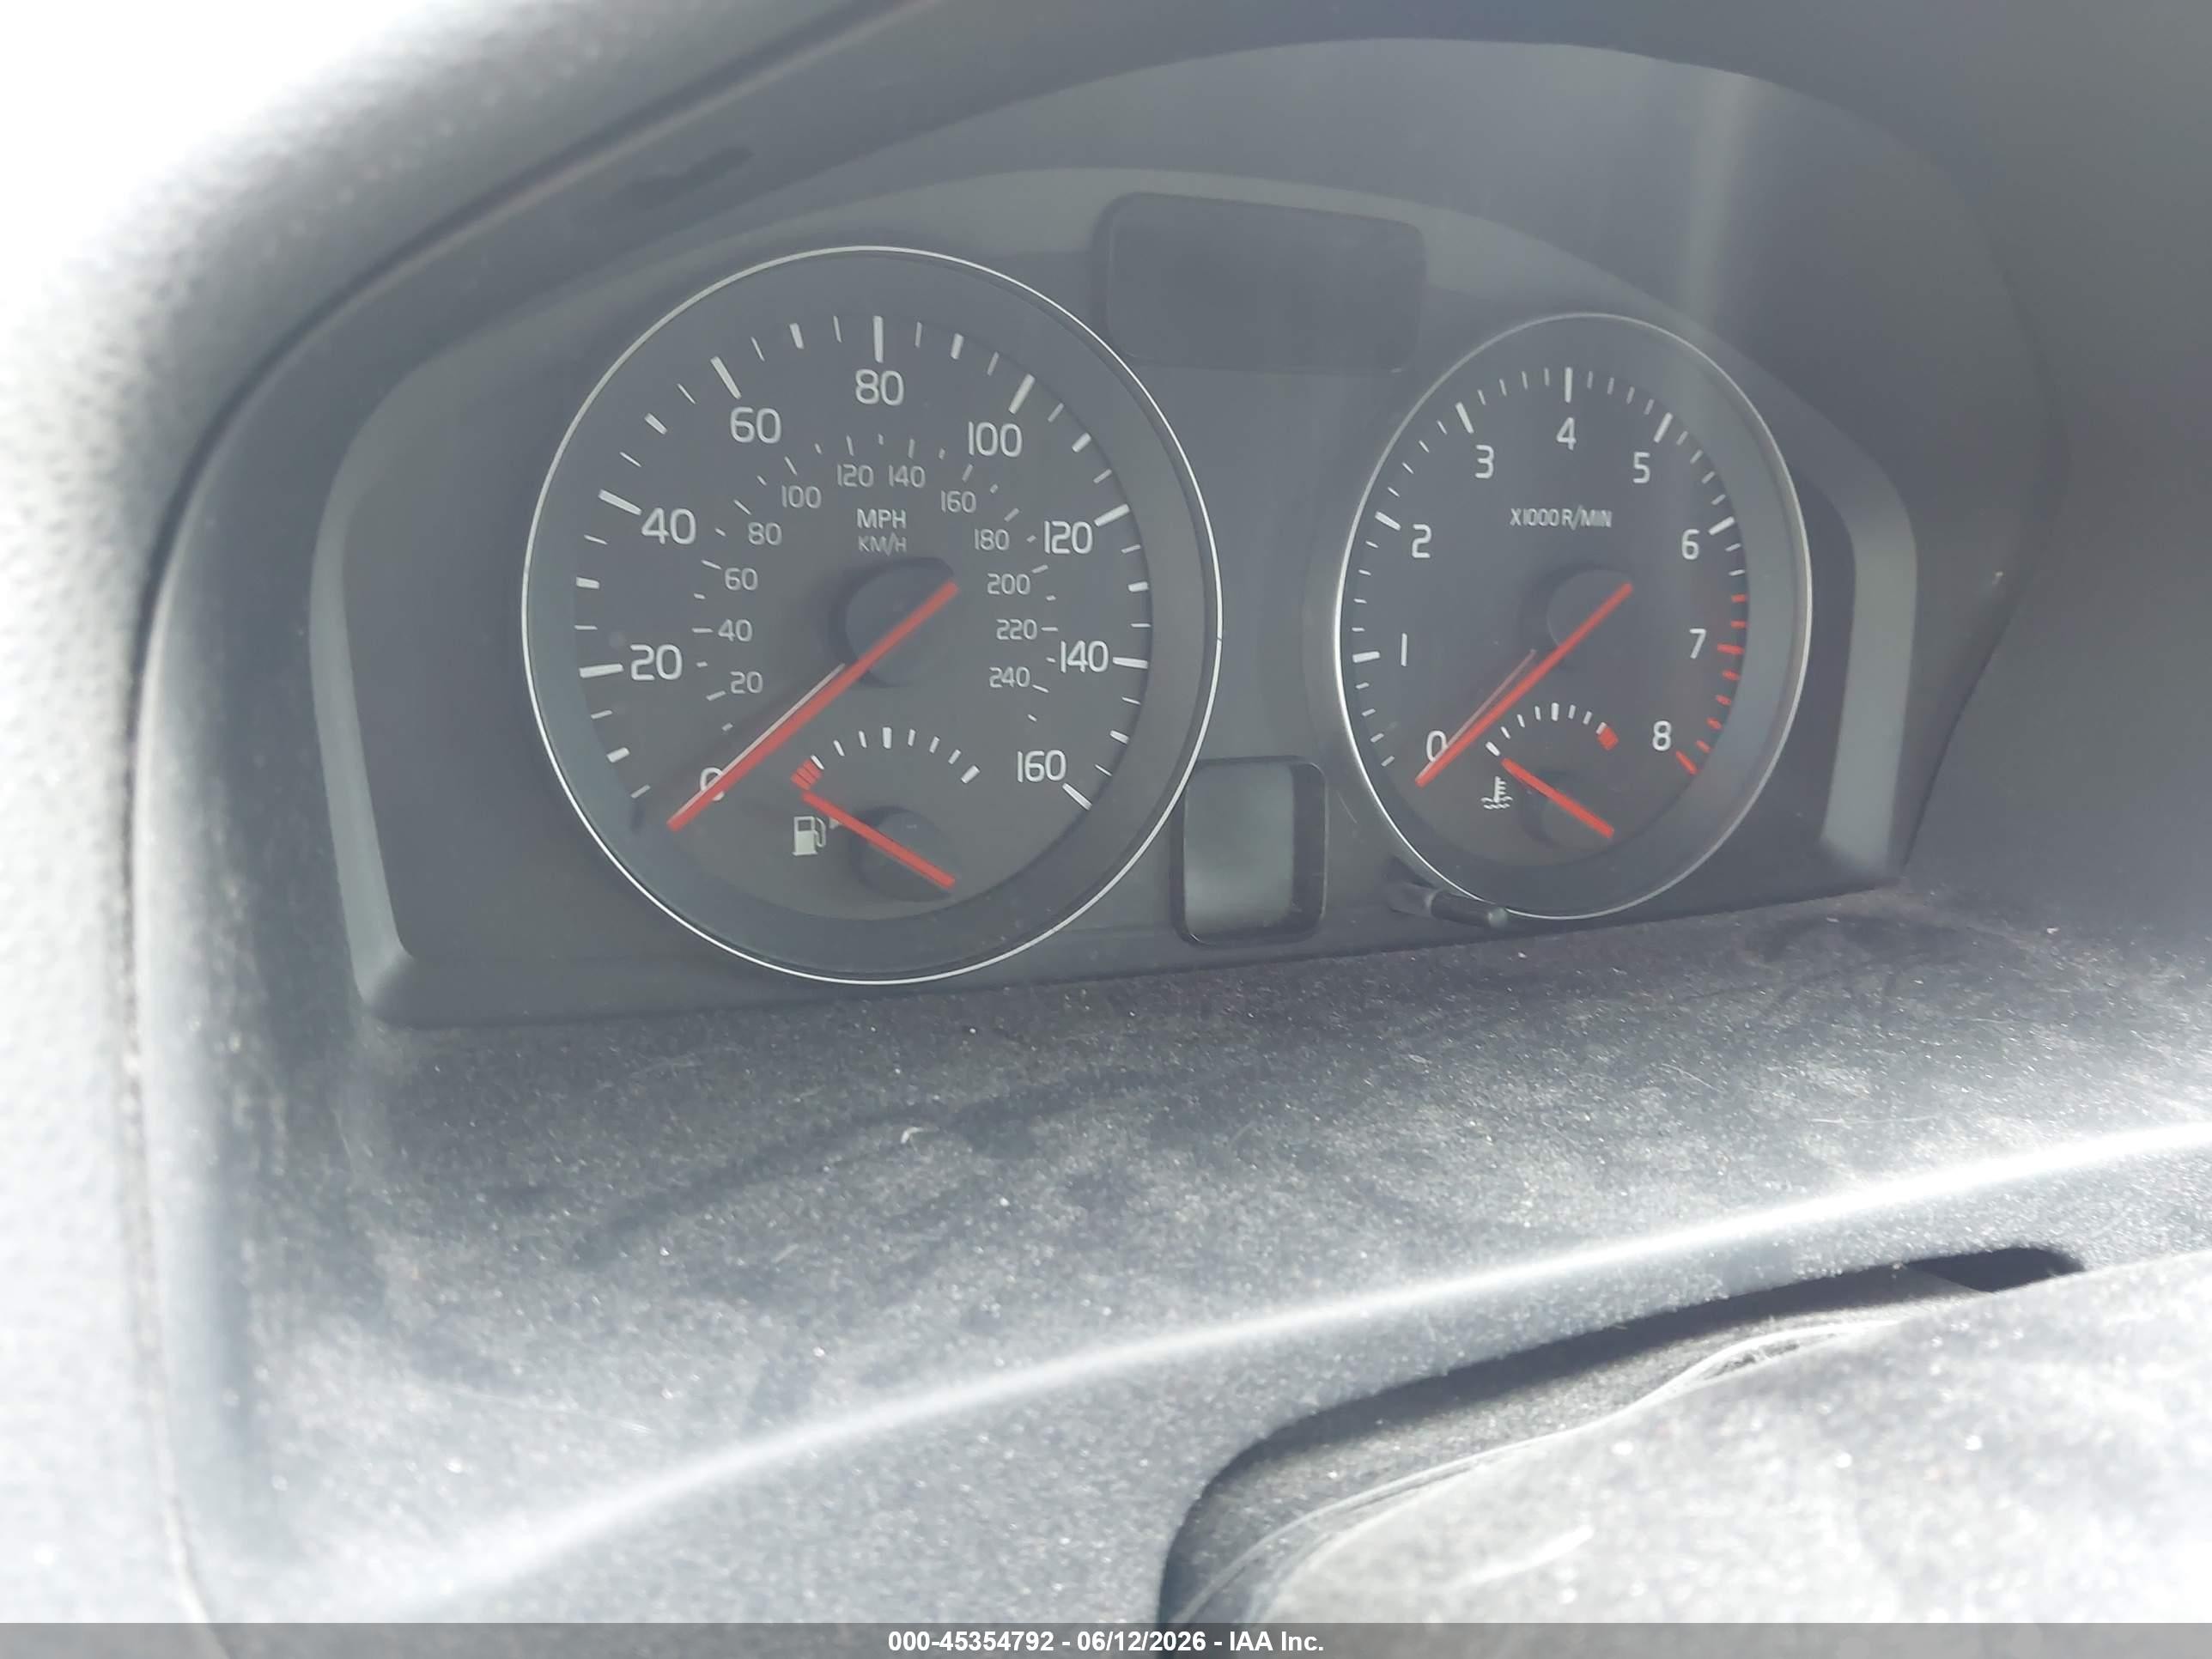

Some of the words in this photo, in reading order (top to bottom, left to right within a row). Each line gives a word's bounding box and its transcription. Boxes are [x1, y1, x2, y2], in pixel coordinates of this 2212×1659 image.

[854, 368, 905, 406] 80
[730, 406, 781, 443] 60
[968, 422, 1023, 458] 100
[1556, 416, 1577, 449] 4
[836, 464, 874, 488] 120
[888, 465, 926, 488] 140
[1474, 445, 1495, 479] 3
[1632, 452, 1650, 483] 5
[781, 485, 822, 508] 100
[941, 490, 975, 514] 160
[641, 507, 696, 544] 40
[747, 522, 782, 545] 80
[857, 508, 906, 529] MPH
[858, 532, 907, 556] KM/H
[975, 529, 1011, 551] 180
[1044, 520, 1093, 554] 120
[1411, 524, 1432, 558] 2
[1681, 529, 1699, 560] 6
[724, 568, 758, 591] 60
[987, 574, 1030, 594] 200
[718, 619, 753, 642] 40
[995, 618, 1037, 640] 220
[1689, 628, 1706, 659] 7
[630, 644, 683, 681] 20
[1060, 640, 1109, 673] 140
[1401, 633, 1407, 666] 1
[730, 672, 763, 694] 20
[989, 666, 1030, 688] 240
[1426, 731, 1449, 763] 0
[1652, 720, 1672, 751] 8
[1017, 750, 1066, 783] 160
